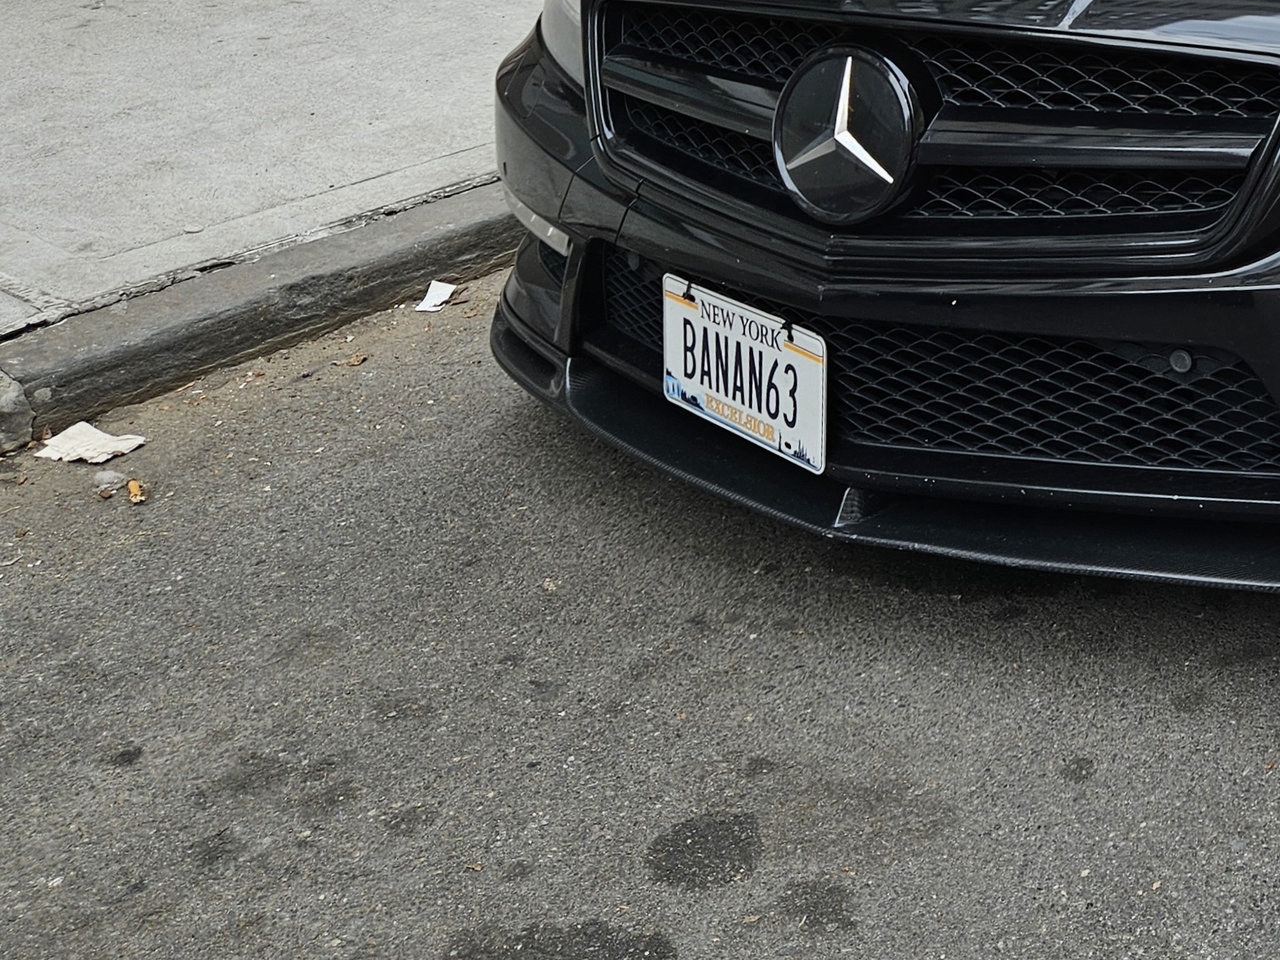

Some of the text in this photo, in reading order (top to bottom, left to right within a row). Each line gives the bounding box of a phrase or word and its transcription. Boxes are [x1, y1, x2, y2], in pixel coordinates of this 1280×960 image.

[700, 299, 783, 352] NEW YORK
[682, 316, 798, 429] BANAN63
[704, 393, 776, 443] EXCELSIOR
